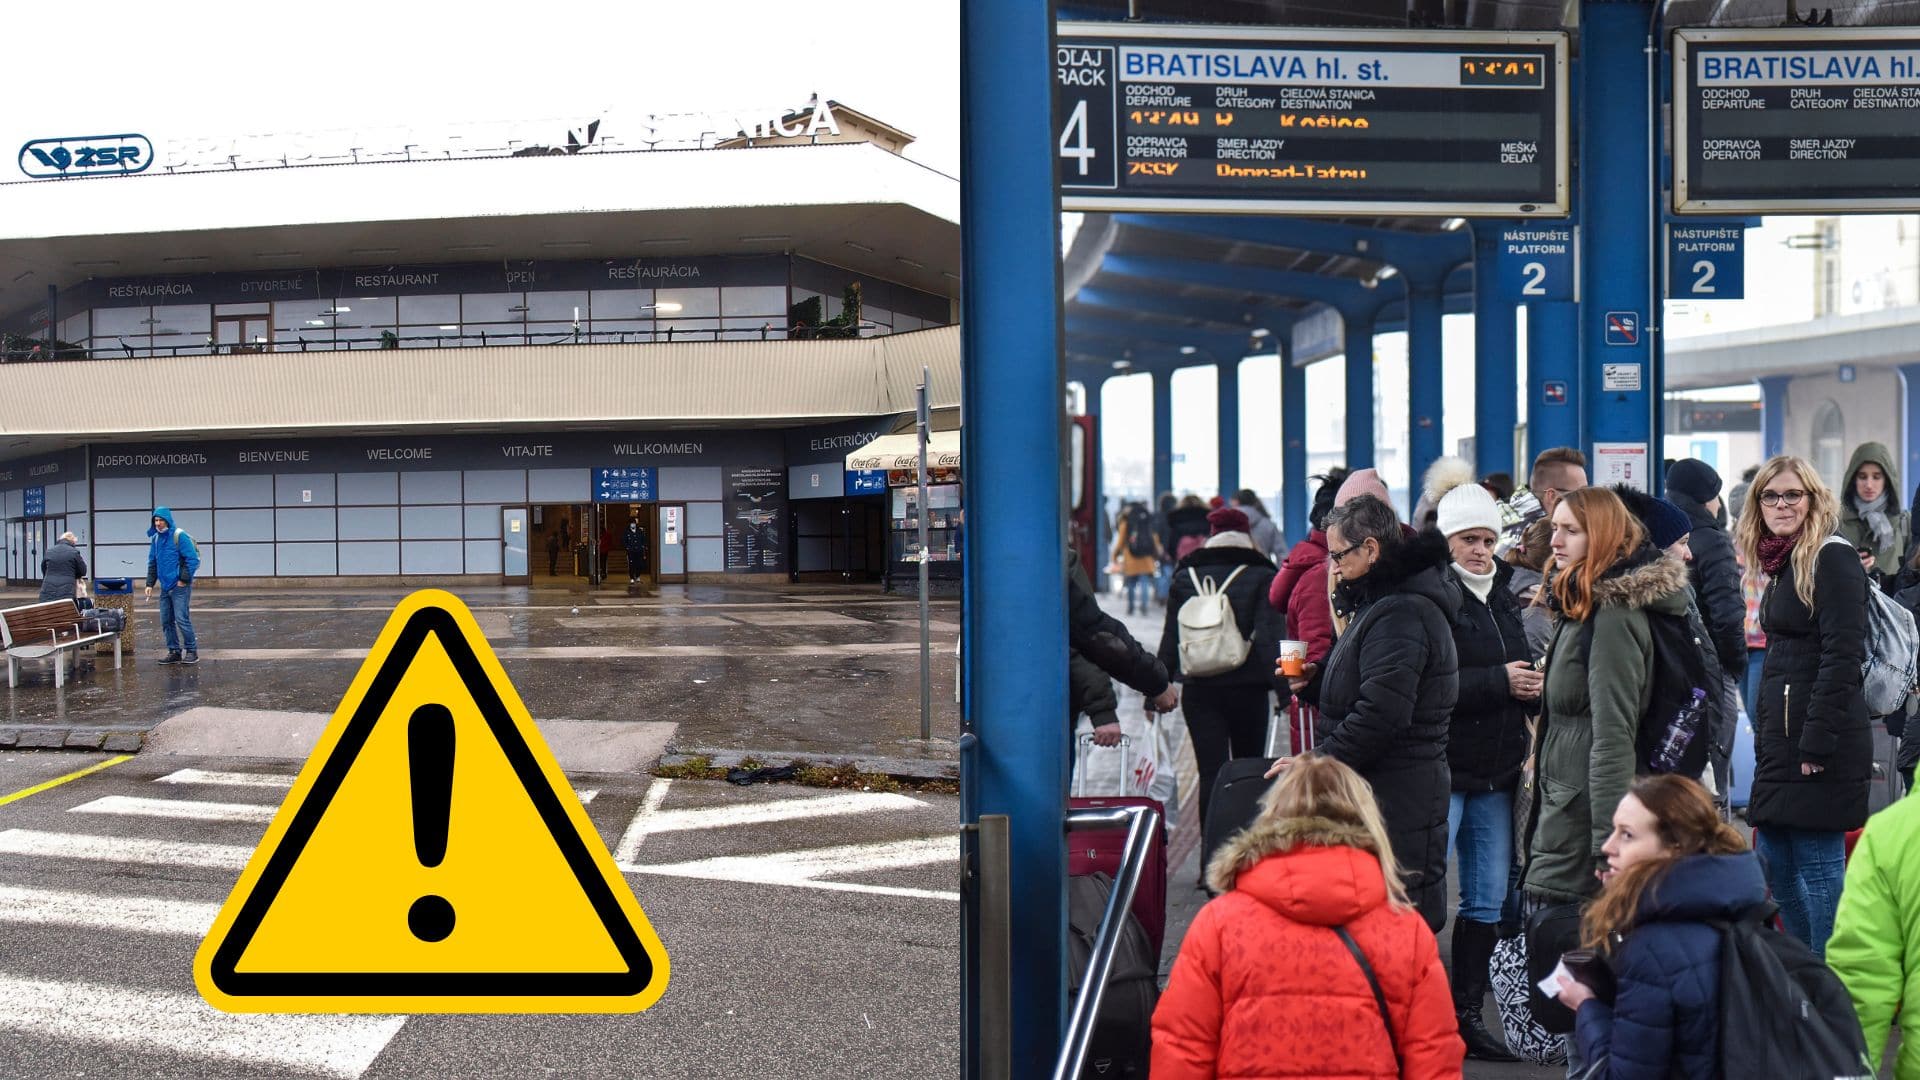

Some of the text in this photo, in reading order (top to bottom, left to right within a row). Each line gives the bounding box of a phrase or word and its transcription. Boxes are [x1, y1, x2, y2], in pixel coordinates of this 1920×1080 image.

[1126, 53, 1389, 81] BRATISLAVA hl. st.
[1703, 55, 1920, 80] BRATISLAVA hl.
[1125, 85, 1176, 96] ODCHOD
[1215, 87, 1248, 97] DRUH
[1329, 89, 1376, 100] STANICA
[1702, 89, 1750, 99] ODCHOD
[1790, 88, 1821, 98] DRUH
[1125, 96, 1192, 107] DEPARTURE
[1215, 98, 1277, 109] CATEGORY
[1280, 99, 1353, 110] DESTINATION
[1702, 99, 1766, 109] DEPARTURE
[1790, 99, 1849, 109] CATEGORY
[1059, 99, 1096, 176] 4
[1126, 136, 1188, 148] DOPRAVCA
[1216, 138, 1285, 150] SMER JAZDY
[1500, 141, 1538, 154] MEŠKÁ
[1702, 140, 1762, 150] DOPRAVCA
[1789, 139, 1857, 150] SMER JAZDY
[1126, 147, 1188, 158] OPERATOR
[1216, 149, 1276, 160] DIRECTION
[1702, 150, 1761, 160] OPERATOR
[1789, 150, 1848, 160] DIRECTION
[1500, 153, 1536, 164] DELAY
[1503, 229, 1569, 241] NÁSTUPIŠTE
[1673, 228, 1740, 239] NÁSTUPIŠTE
[1508, 244, 1566, 254] PLATFORM
[1678, 243, 1735, 252] PLATFORM
[355, 272, 439, 287] RESTAURANT
[506, 271, 535, 284] OPEN
[1522, 262, 1546, 295] 2
[1692, 260, 1716, 293] 2
[810, 431, 878, 451] ELEKTRIČKY
[367, 447, 432, 460] WELCOME
[502, 445, 553, 457] VITAJTE
[613, 443, 703, 455] WILLKOMMEN
[97, 455, 133, 467] ДОБРО
[239, 450, 309, 463] BIENVENUE
